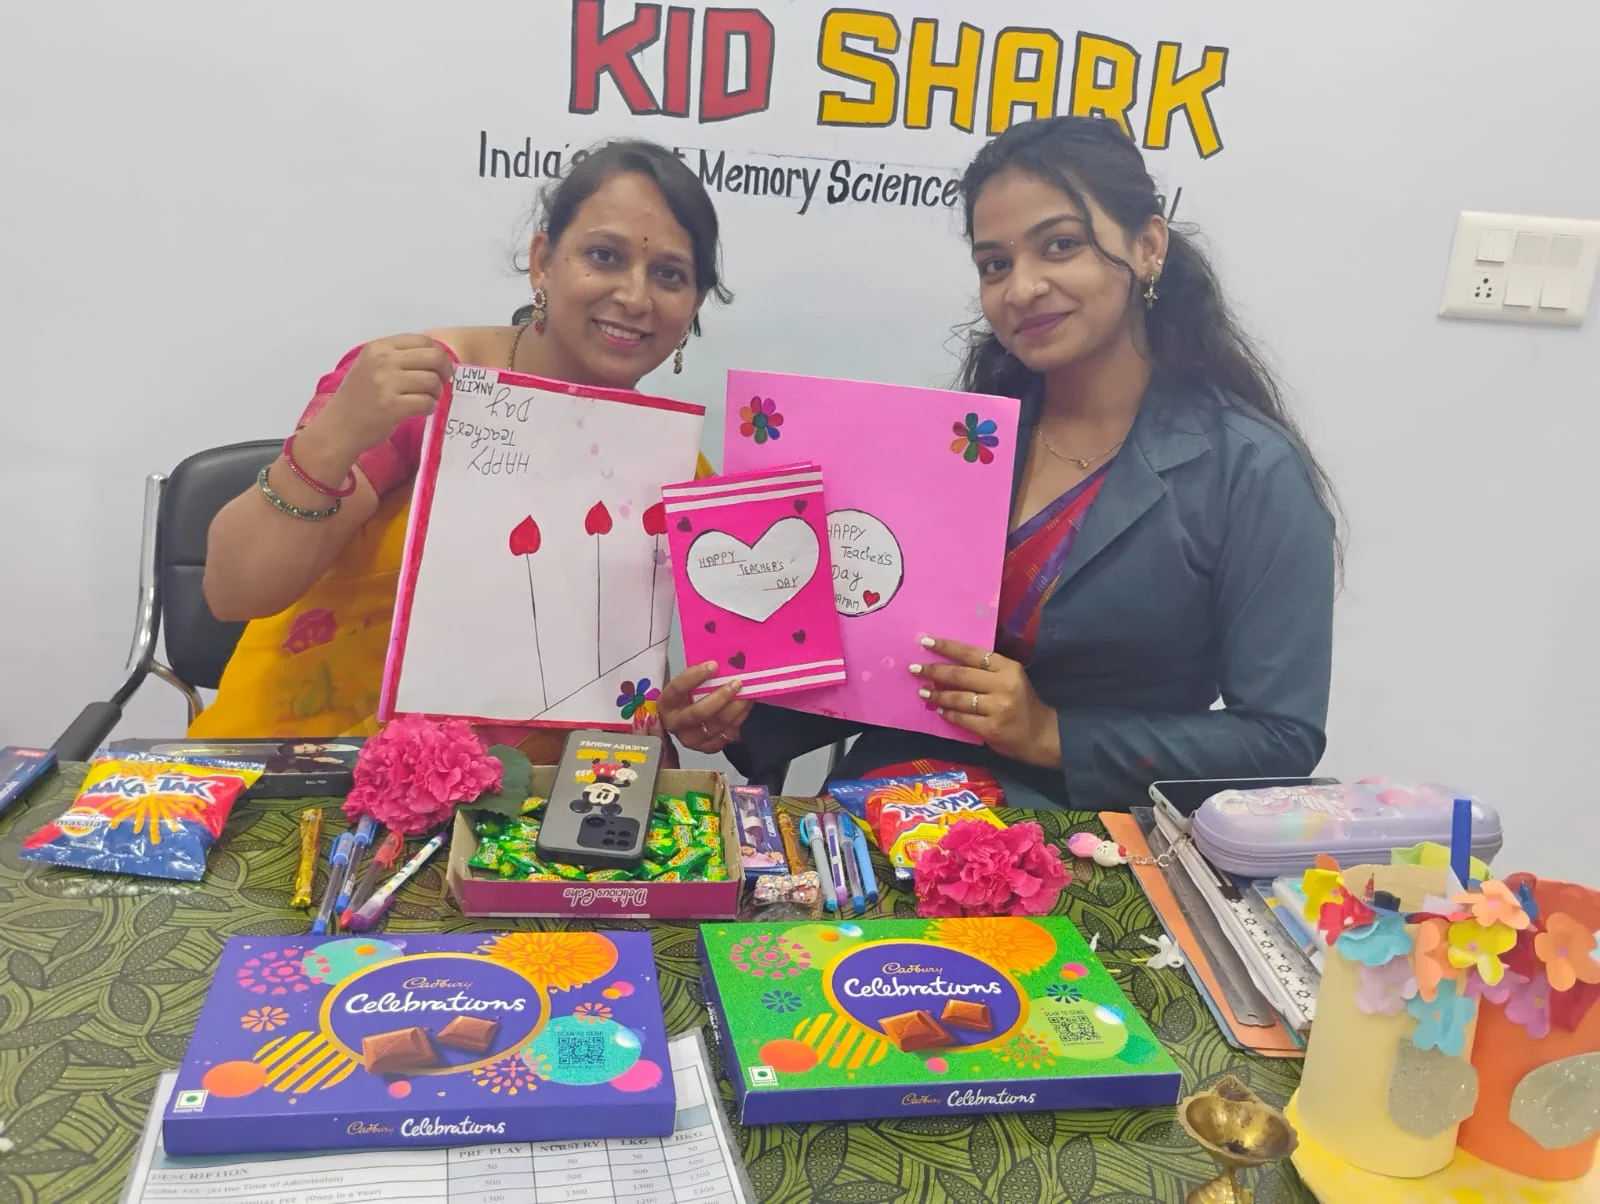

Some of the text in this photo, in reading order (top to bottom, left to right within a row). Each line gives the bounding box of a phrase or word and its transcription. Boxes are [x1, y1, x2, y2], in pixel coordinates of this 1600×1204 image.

[568, 0, 1229, 159] KID SHARK
[699, 148, 822, 216] Memory
[826, 159, 961, 207] Science
[462, 368, 487, 380] MAM
[485, 387, 535, 422] Day
[467, 446, 530, 475] HAPPY
[698, 550, 736, 568] HAPPY
[738, 560, 785, 575] TEACHER'S
[776, 576, 799, 588] DAY
[580, 740, 650, 751] MICKEY MOUSE
[563, 888, 648, 907] Delicious Cake
[882, 962, 943, 975] Cadbury
[402, 976, 473, 989] Cadbury
[844, 976, 1002, 997] Celebrations
[345, 991, 526, 1014] Celebrations
[902, 1088, 1037, 1107] Cadbury Celebrations
[346, 1115, 506, 1136] Cadbury Celebrations
[540, 1139, 600, 1152] NURSERY
[621, 1138, 649, 1146] LKG
[459, 1146, 523, 1158] PRE PLAY
